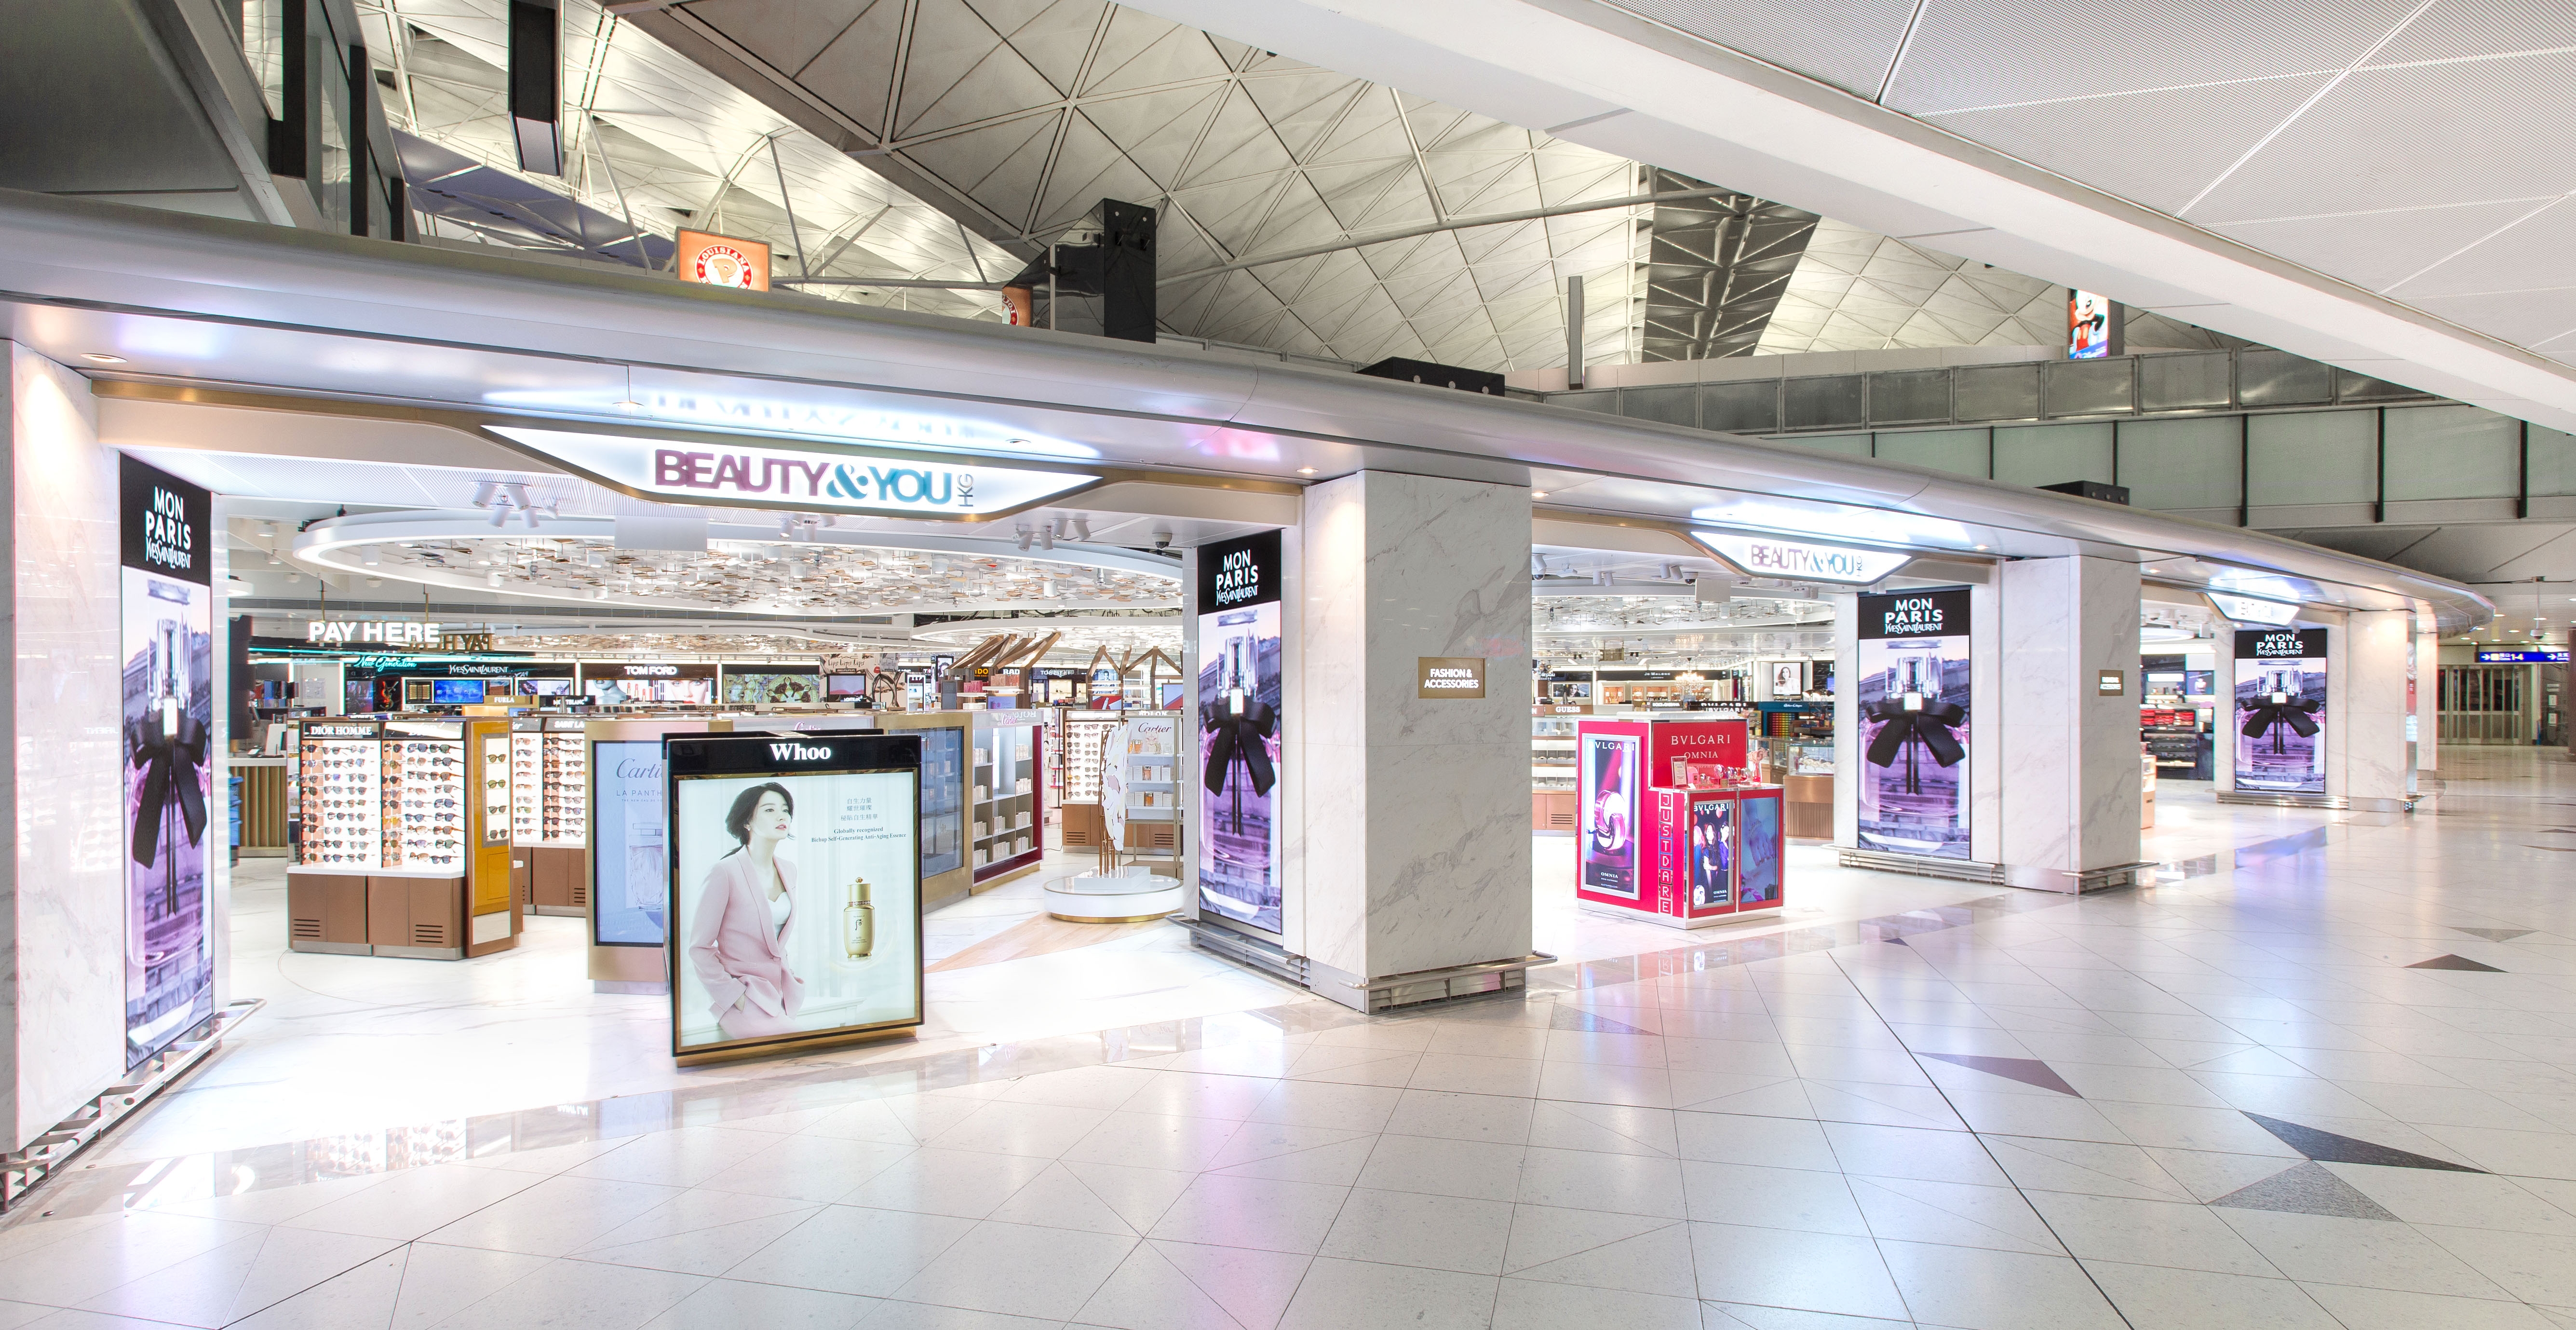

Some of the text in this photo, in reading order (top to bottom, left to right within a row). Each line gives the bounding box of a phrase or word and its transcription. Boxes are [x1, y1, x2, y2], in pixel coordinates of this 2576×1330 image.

[698, 247, 750, 272] LOUISIANA
[957, 472, 974, 507] HKG
[154, 486, 184, 522] MON
[145, 510, 191, 550] PARIS
[1223, 549, 1251, 572] MON
[1216, 565, 1258, 590] PARIS
[1895, 598, 1933, 611] MON
[1884, 609, 1943, 624] PARIS
[309, 622, 357, 641] PAY
[364, 622, 440, 642] HERE
[2265, 633, 2295, 642] MON
[2256, 641, 2304, 649] PARIS
[354, 655, 417, 672] New Generation
[624, 665, 677, 675] TOM FORD
[1430, 668, 1472, 678] FASHION &
[1424, 679, 1479, 688] ACCESSORIES
[310, 726, 372, 735] DIOR HOMME
[1138, 722, 1172, 733] Cartier
[1671, 734, 1730, 745] BVLGARI
[769, 743, 831, 760] Whoo
[616, 758, 662, 778] Carti
